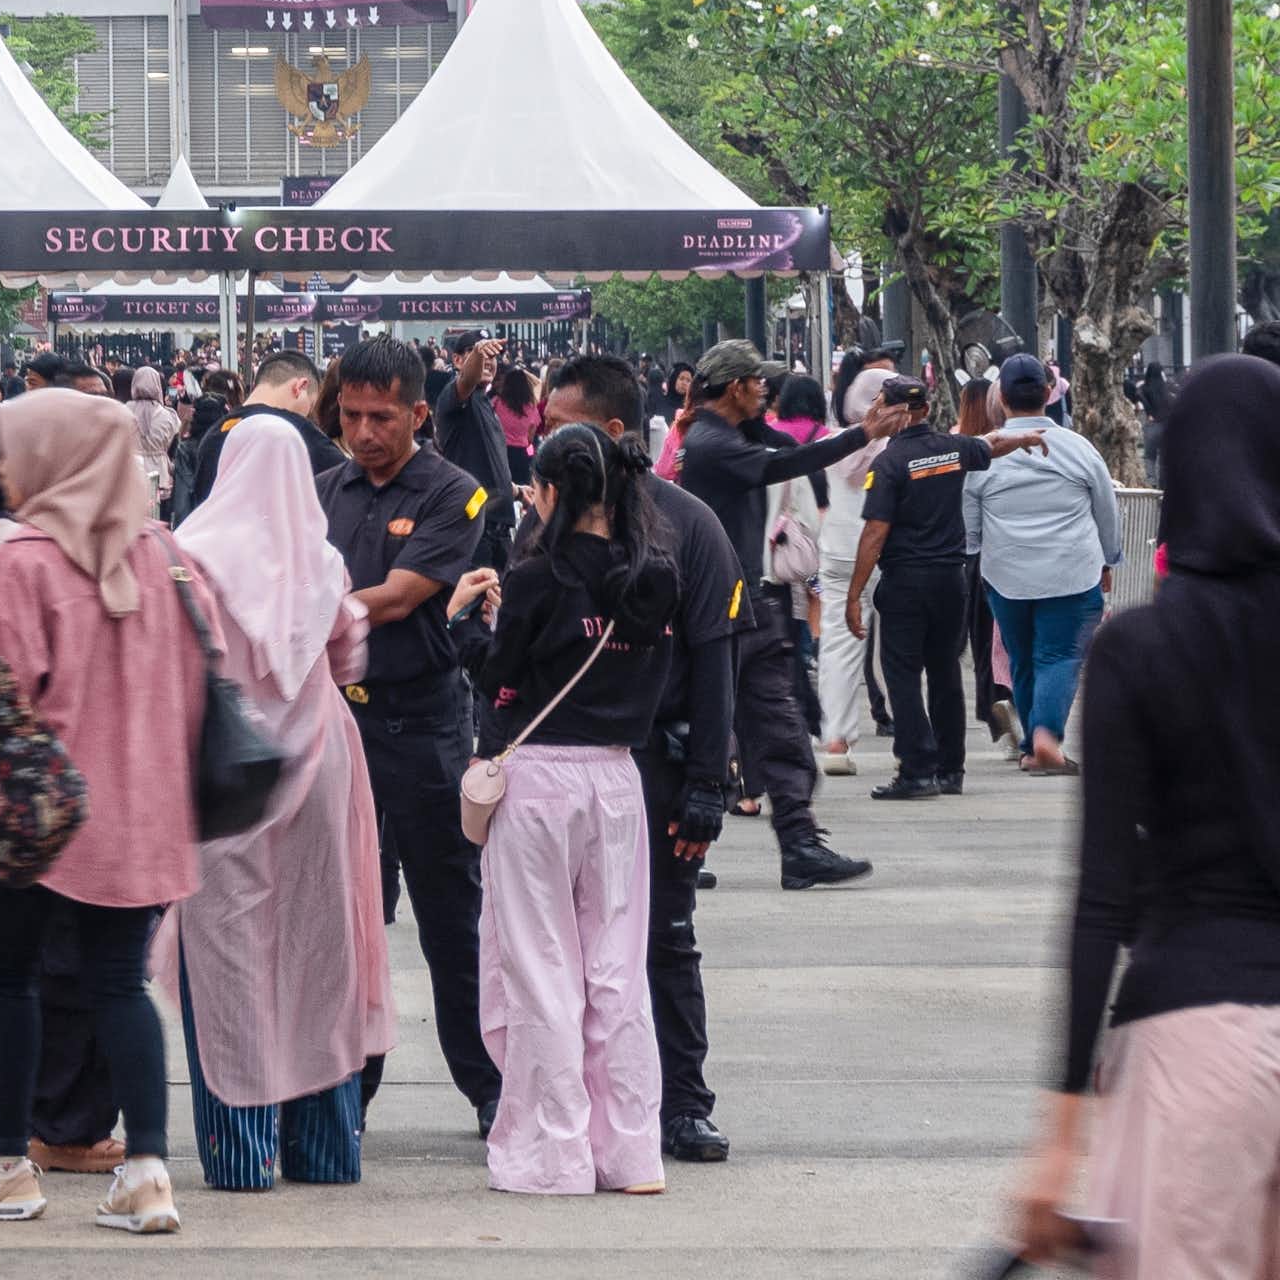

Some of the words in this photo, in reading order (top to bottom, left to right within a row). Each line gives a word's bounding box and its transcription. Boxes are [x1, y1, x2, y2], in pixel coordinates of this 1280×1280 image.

[45, 226, 243, 253] SECURITY
[254, 226, 395, 253] CHECK
[683, 234, 784, 249] DEADLINE
[123, 301, 190, 315] TICKET
[399, 300, 466, 314] TICKET
[471, 300, 517, 313] SCAN
[908, 451, 960, 469] CROWD
